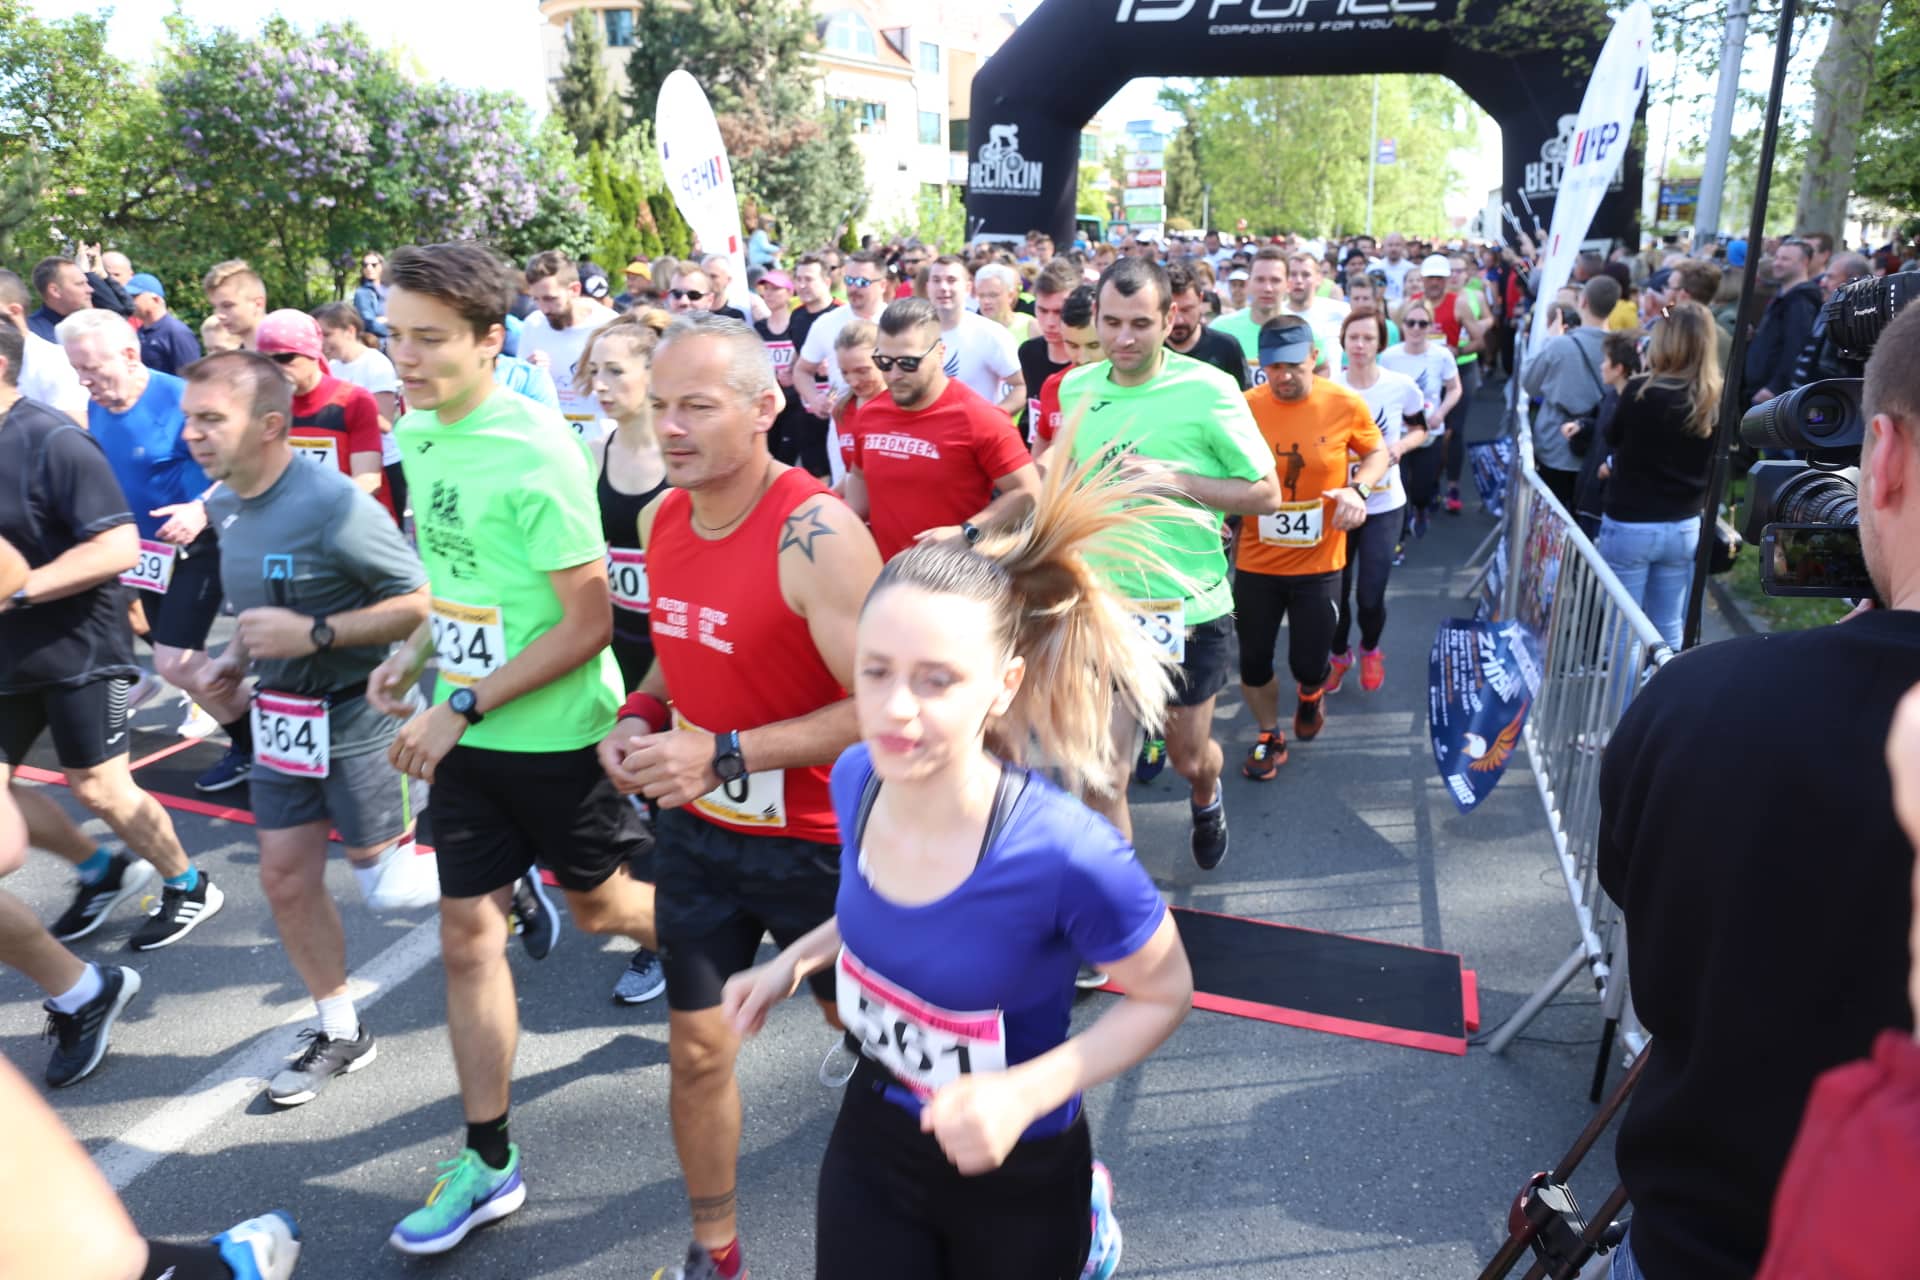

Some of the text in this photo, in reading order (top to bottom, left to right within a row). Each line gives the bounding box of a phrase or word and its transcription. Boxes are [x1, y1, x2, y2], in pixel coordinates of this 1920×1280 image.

[1208, 21, 1315, 35] COMPONENTS
[1319, 20, 1355, 31] FOR
[865, 435, 937, 458] STRONGER
[1275, 512, 1310, 535] 34
[257, 708, 318, 755] 564
